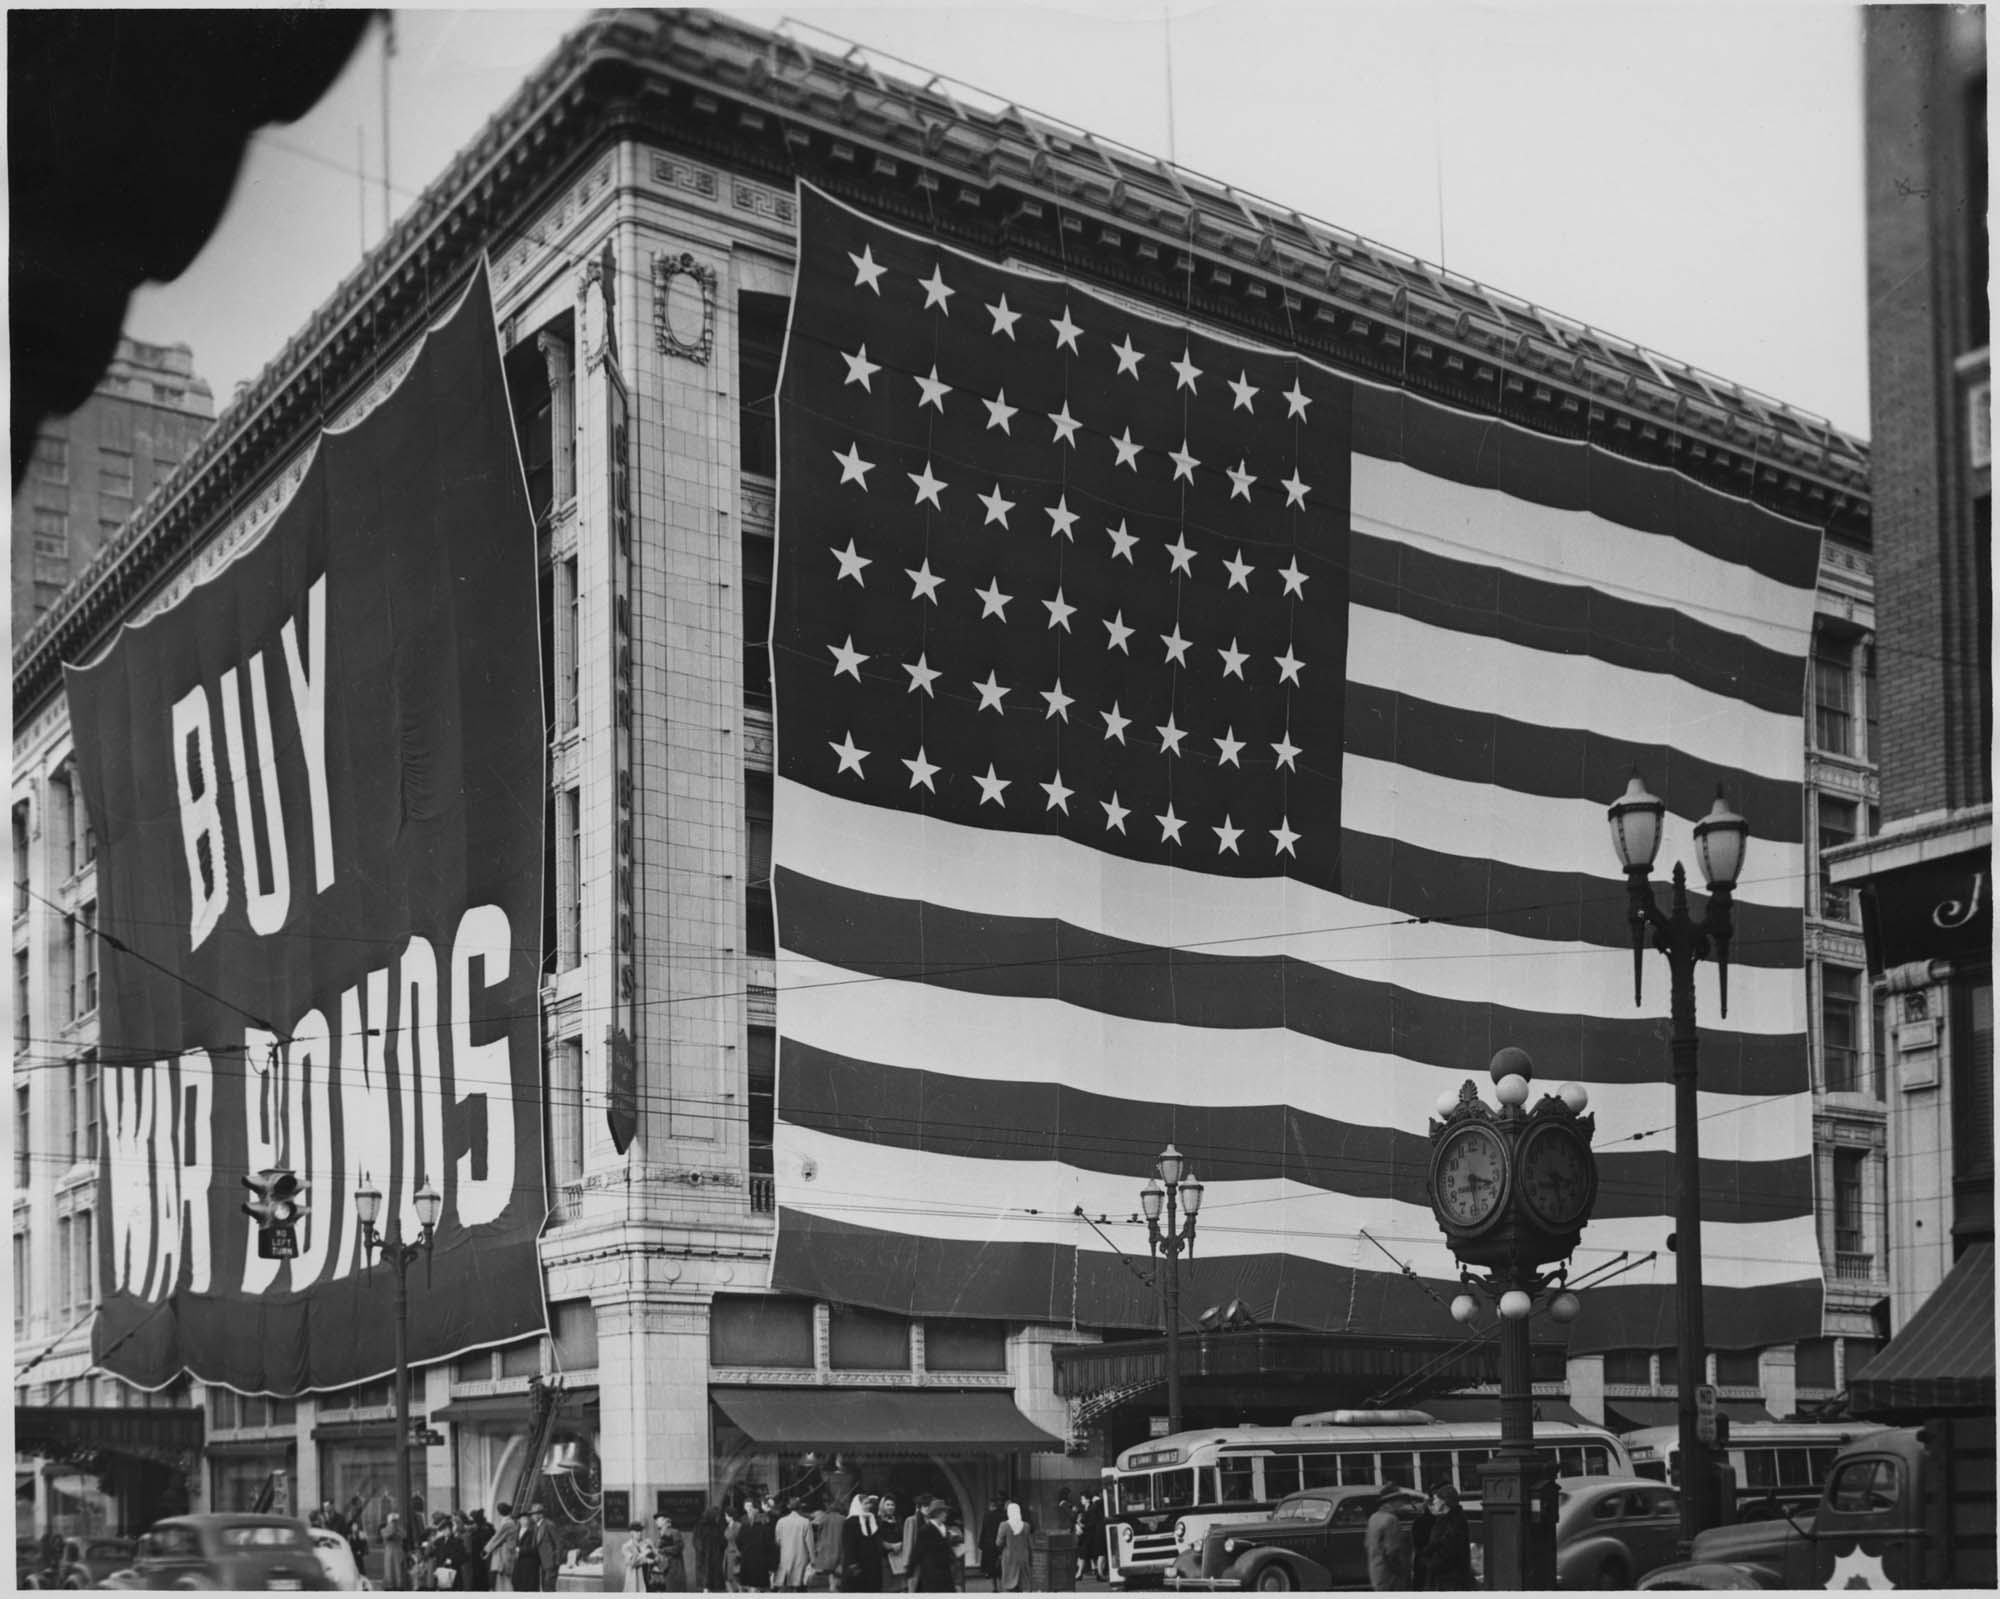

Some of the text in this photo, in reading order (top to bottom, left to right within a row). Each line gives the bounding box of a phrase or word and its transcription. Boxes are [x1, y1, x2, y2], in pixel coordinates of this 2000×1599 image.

[172, 571, 335, 952] BUY
[1932, 872, 1985, 928] J
[103, 904, 516, 1303] WAR BONDS
[275, 1229, 287, 1238] NO
[271, 1238, 291, 1247] LEFT
[271, 1247, 293, 1256] TURN
[1700, 1390, 1712, 1404] NO
